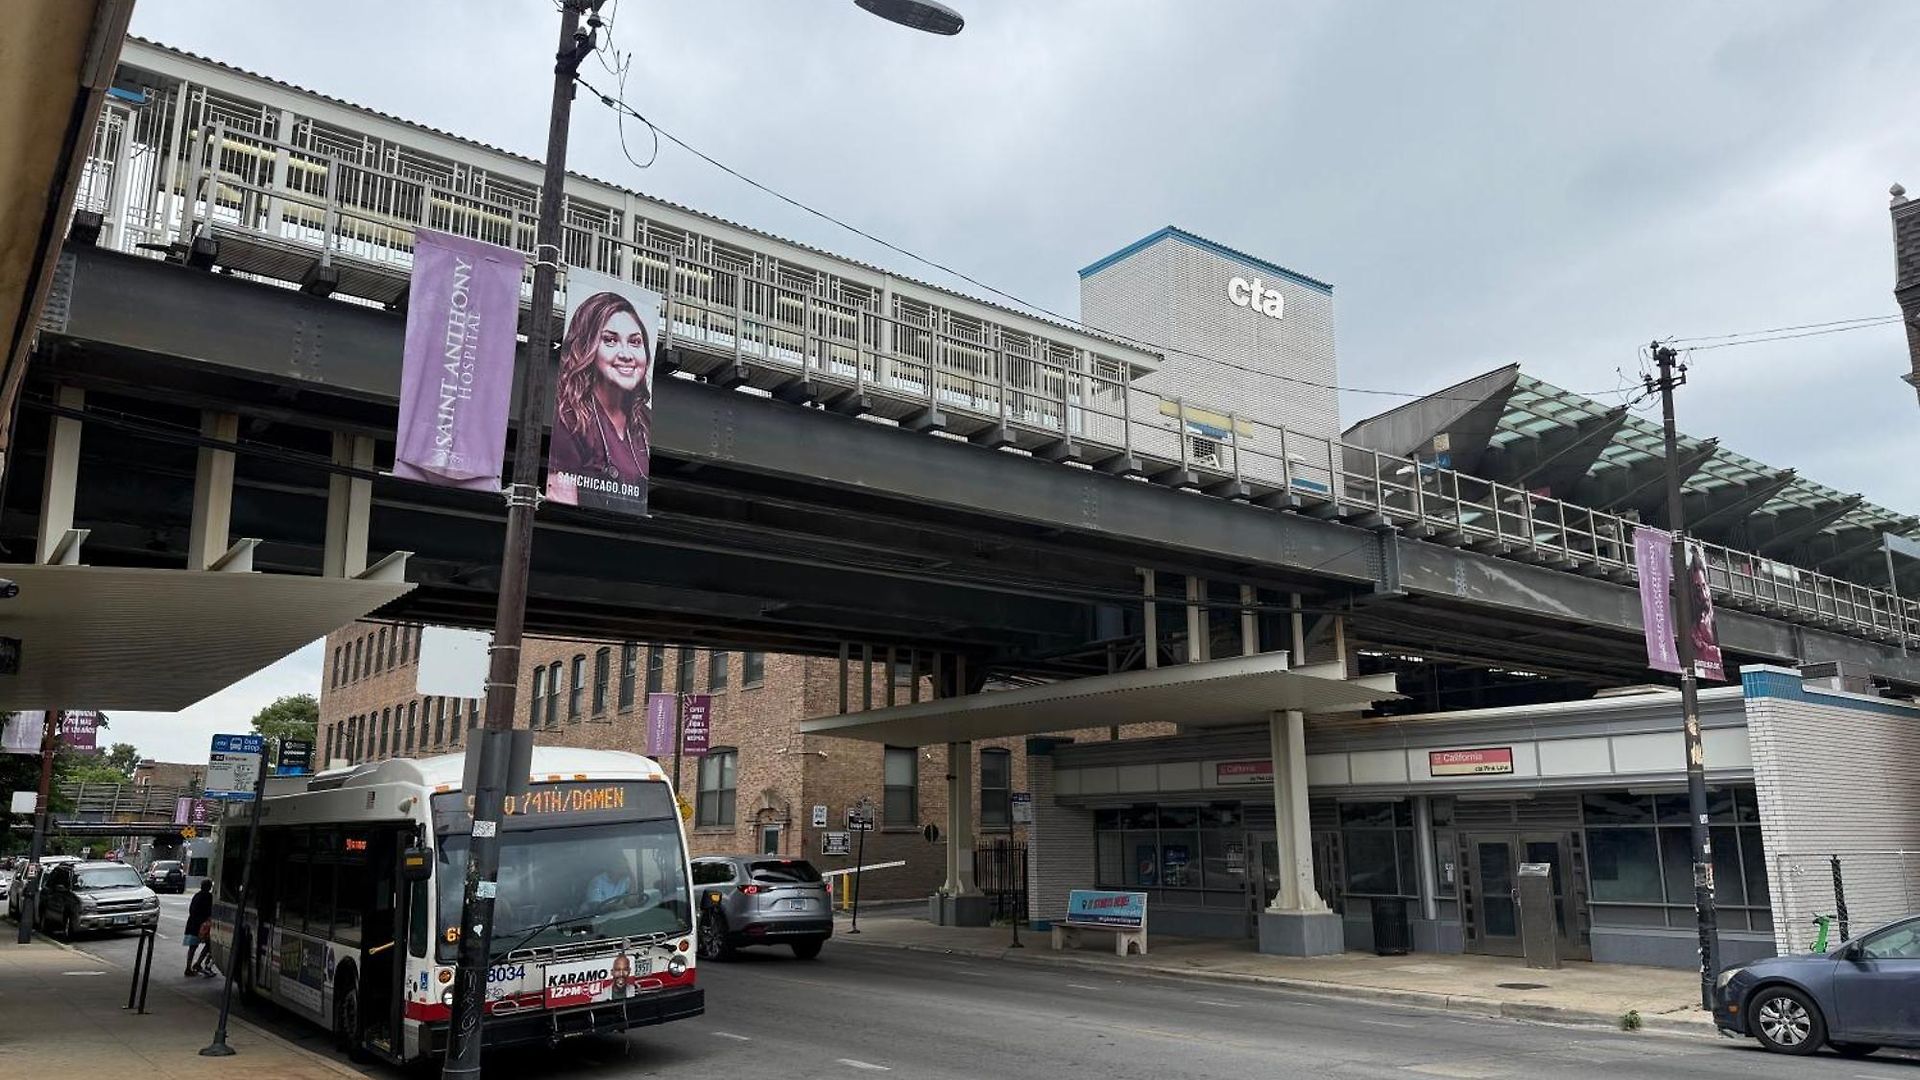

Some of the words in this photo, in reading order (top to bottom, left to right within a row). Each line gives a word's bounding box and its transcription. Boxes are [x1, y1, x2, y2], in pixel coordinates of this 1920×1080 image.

[1228, 276, 1284, 320] cta
[444, 257, 473, 378] ANTHONY
[457, 312, 481, 400] HOSPITAL
[436, 377, 459, 449] SAINT
[558, 471, 640, 497] SAHCHICAGO.ORG
[245, 744, 261, 753] stop
[1443, 752, 1483, 762] California
[521, 786, 625, 815] 74TH/DAMEN
[487, 964, 526, 983] 8034
[549, 968, 609, 987] KARAMO
[550, 984, 582, 999] 12PM
